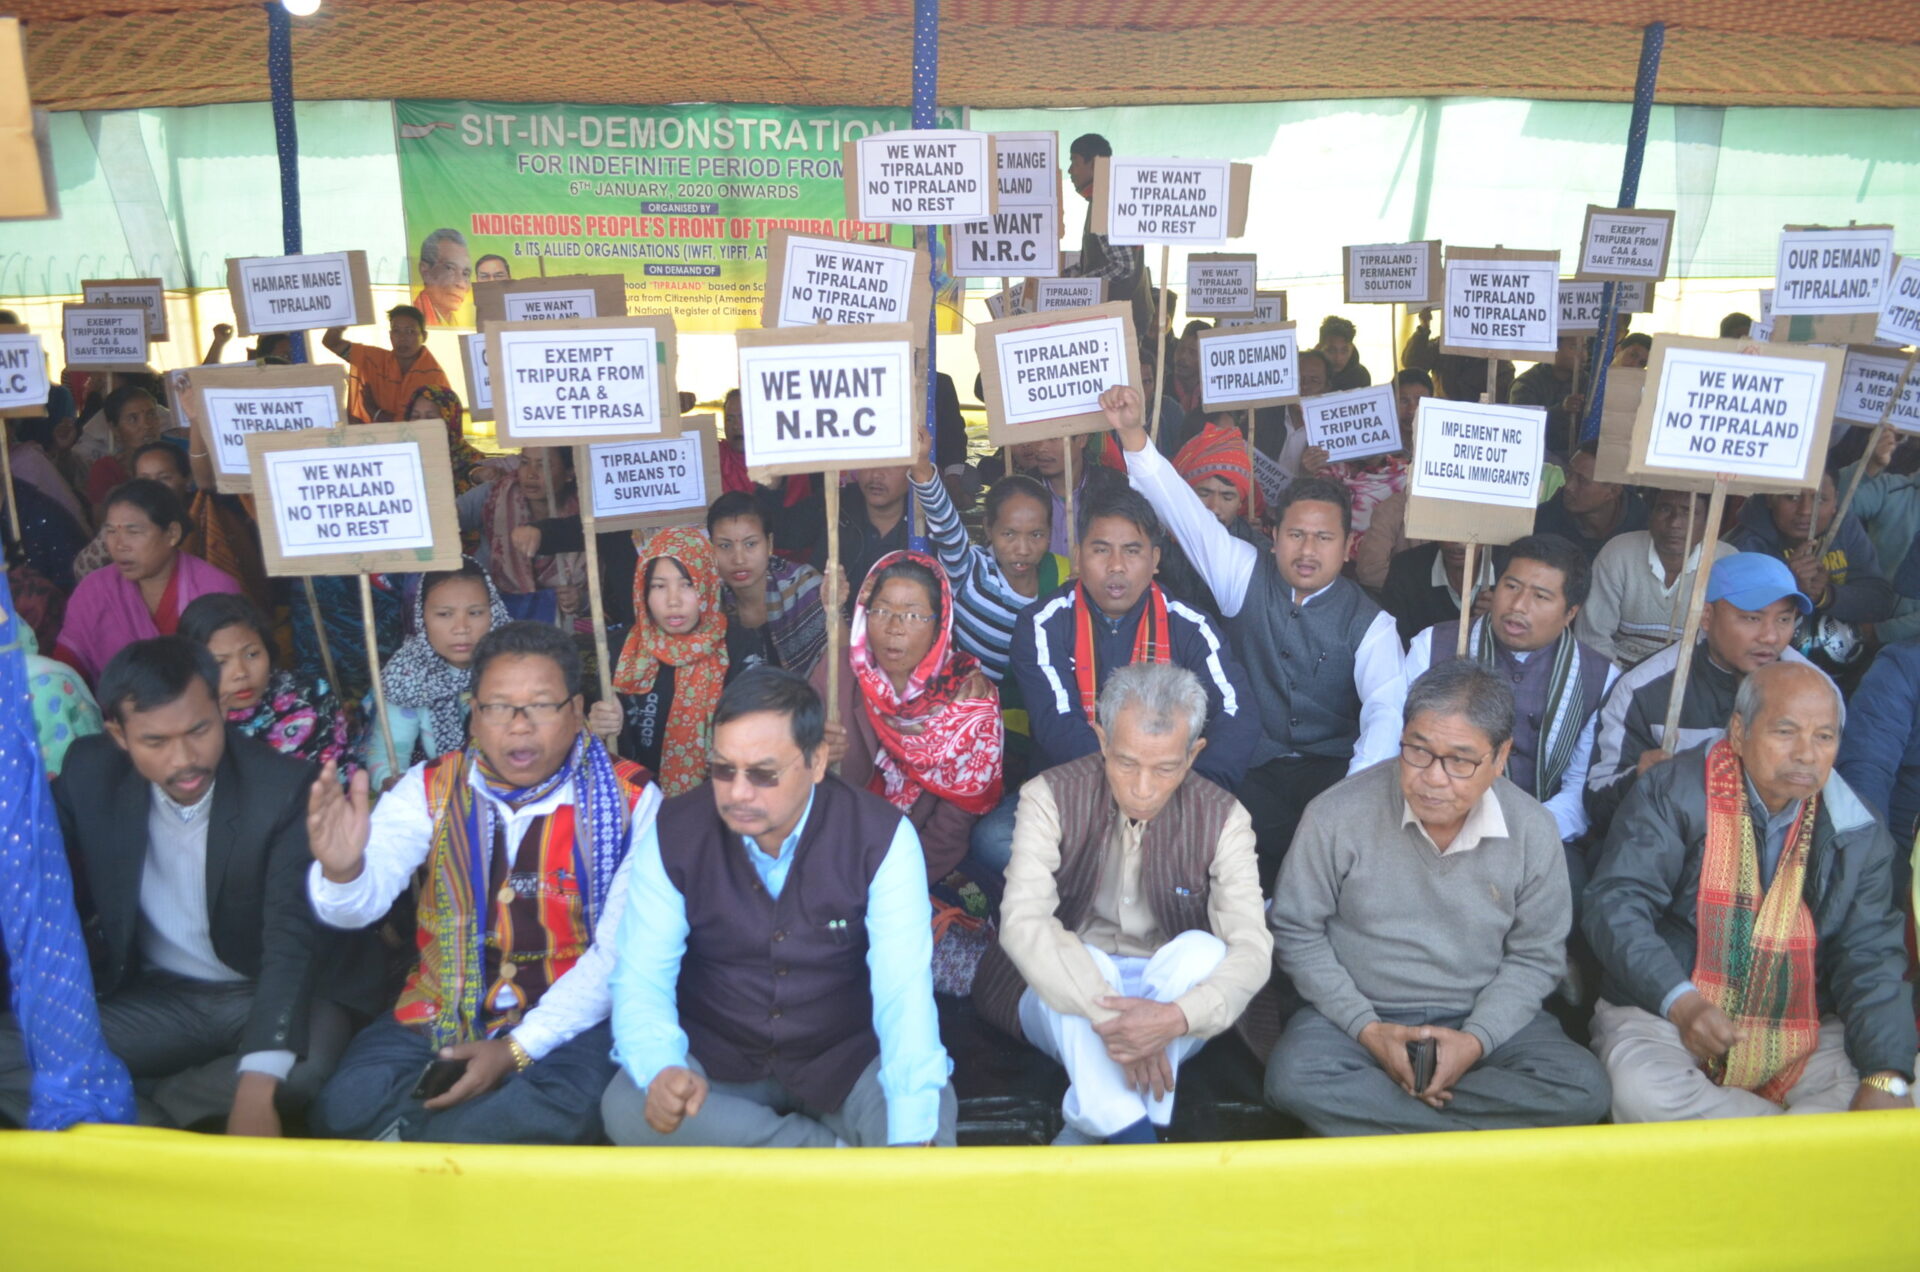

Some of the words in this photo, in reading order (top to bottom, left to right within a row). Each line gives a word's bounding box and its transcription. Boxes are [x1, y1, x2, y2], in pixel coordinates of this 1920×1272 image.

[886, 144, 909, 160] WE
[913, 143, 957, 159] WANT
[517, 154, 563, 174] FOR
[569, 156, 691, 177] INDEFINITE
[698, 157, 780, 179] PERIOD
[1006, 151, 1047, 170] MANGE
[880, 161, 964, 178] TIPRALAND
[1137, 170, 1158, 184] WE
[1162, 170, 1202, 184] WANT
[677, 184, 713, 198] 2020
[717, 184, 799, 199] ONWARDS
[868, 180, 889, 195] NO
[893, 178, 977, 195] TIPRALAND
[1130, 187, 1207, 201] TIPRALAND
[648, 203, 698, 213] ORGANISED
[700, 203, 712, 213] BY
[891, 198, 913, 212] NO
[917, 197, 955, 212] REST
[1117, 203, 1138, 216] NO
[1141, 203, 1218, 218] TIPRALAND
[471, 214, 582, 236] INDIGENOUS
[669, 217, 726, 239] FRONT
[729, 218, 753, 239] OF
[994, 212, 1043, 235] WANT
[1137, 220, 1157, 234] NO
[1161, 220, 1196, 234] REST
[1610, 224, 1647, 236] EXEMPT
[1593, 234, 1632, 245] TRIPURA
[1634, 236, 1659, 247] FROM
[514, 242, 522, 256] &
[525, 242, 541, 256] ITS
[544, 243, 580, 257] ALLIED
[584, 243, 680, 259] ORGANISATIONS
[971, 240, 1037, 262] N.R.C
[1610, 245, 1629, 256] CAA
[1630, 246, 1638, 256] &
[1787, 249, 1819, 270] OUR
[1821, 247, 1881, 269] DEMAND
[815, 253, 837, 270] WE
[842, 256, 885, 275] WANT
[1360, 255, 1412, 266] TIPRALAND
[1591, 254, 1613, 265] SAVE
[1615, 256, 1654, 268] TIPRASA
[649, 265, 664, 274] ON
[665, 265, 702, 275] DEMAND
[704, 266, 716, 275] OF
[1201, 269, 1214, 277] WE
[1216, 268, 1239, 277] WANT
[1359, 267, 1417, 278] PERMANENT
[251, 274, 299, 293] HAMARE
[302, 271, 342, 288] MANGE
[708, 282, 737, 291] based
[806, 270, 889, 294] TIPRALAND
[1197, 278, 1243, 286] TIPRALAND
[1364, 280, 1412, 291] SOLUTION
[1469, 273, 1489, 287] WE
[1491, 274, 1530, 288] WANT
[642, 293, 663, 302] from
[664, 293, 713, 305] Citizenship
[791, 285, 813, 301] NO
[818, 289, 897, 312] TIPRALAND
[1045, 287, 1089, 296] TIPRALAND
[1190, 287, 1203, 295] NO
[1205, 287, 1249, 295] TIPRALAND
[1464, 289, 1536, 305] TIPRALAND
[1558, 291, 1574, 305] WE
[268, 294, 332, 314] TIPRALAND
[525, 301, 541, 314] WE
[543, 299, 574, 313] WANT
[1045, 298, 1092, 307] PERMANENT
[1202, 297, 1215, 305] NO
[1216, 297, 1237, 305] REST
[674, 306, 709, 317] Register
[722, 307, 757, 316] Citizens
[811, 305, 833, 321] NO
[837, 308, 876, 324] REST
[1453, 306, 1471, 319] NO
[1474, 307, 1547, 322] TIPRALAND
[1562, 307, 1600, 321] N.R.C
[86, 317, 123, 327] EXEMPT
[1470, 322, 1489, 336] NO
[1491, 323, 1526, 338] REST
[72, 327, 111, 336] TRIPURA
[113, 327, 139, 336] FROM
[91, 337, 110, 346] CAA
[74, 347, 98, 356] SAVE
[100, 346, 139, 355] TIPRASA
[544, 346, 614, 364] EXEMPT
[1014, 339, 1100, 365] TIPRALAND
[1210, 349, 1236, 367] OUR
[1238, 343, 1287, 364] DEMAND
[516, 366, 592, 384] TRIPURA
[597, 365, 645, 381] FROM
[1017, 357, 1110, 384] PERMANENT
[760, 369, 802, 402] WE
[809, 366, 887, 400] WANT
[1027, 377, 1104, 402] SOLUTION
[1698, 369, 1726, 389] WE
[1731, 373, 1784, 394] WANT
[555, 386, 591, 401] CAA
[596, 385, 608, 400] &
[234, 402, 258, 416] WE
[260, 401, 304, 415] WANT
[522, 404, 567, 421] SAVE
[571, 402, 645, 420] TIPRASA
[1320, 401, 1377, 421] EXEMPT
[1687, 391, 1788, 417] TIPRALAND
[231, 416, 314, 431] TIPRALAND
[775, 406, 877, 441] N.R.C
[1320, 417, 1383, 436] TRIPURA
[1665, 411, 1693, 430] NO
[1698, 413, 1800, 440] TIPRALAND
[223, 433, 244, 447] NO
[1317, 433, 1357, 450] FROM
[1360, 429, 1391, 443] CAA
[1441, 420, 1500, 443] IMPLEMENT
[1501, 427, 1522, 445] NRC
[1453, 443, 1483, 461] DRIVE
[1486, 447, 1508, 464] OUT
[1689, 435, 1717, 454] NO
[1721, 439, 1769, 459] REST
[601, 448, 678, 468] TIPRALAND
[302, 464, 331, 481] WE
[333, 461, 383, 479] WANT
[604, 472, 614, 485] A
[617, 466, 665, 483] MEANS
[668, 464, 686, 479] TO
[1424, 460, 1466, 480] ILLEGAL
[1468, 465, 1530, 487] IMMIGRANTS
[298, 480, 395, 501] TIPRALAND
[613, 482, 681, 501] SURVIVAL
[287, 505, 313, 521] NO
[317, 498, 413, 520] TIPRALAND
[317, 523, 341, 539] NO
[347, 519, 390, 537] REST
